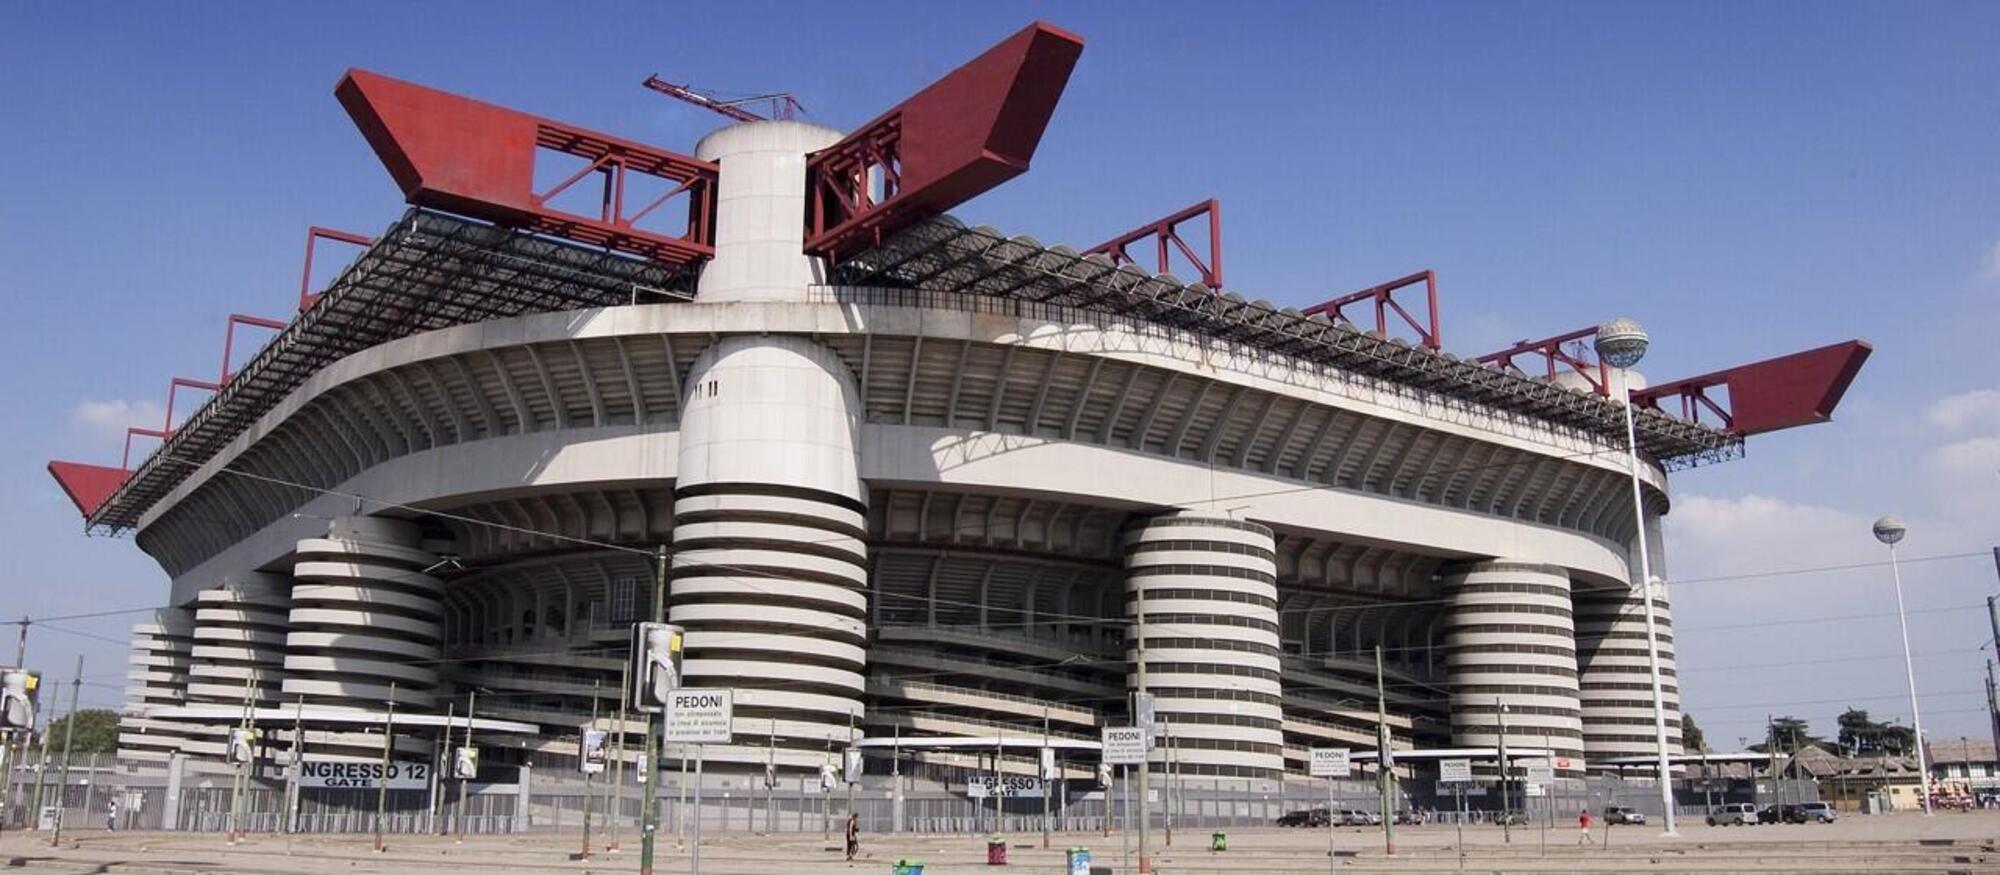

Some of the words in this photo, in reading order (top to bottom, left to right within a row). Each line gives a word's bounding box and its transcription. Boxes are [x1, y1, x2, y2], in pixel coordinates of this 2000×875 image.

[676, 695, 723, 708] PEDONI
[1109, 731, 1140, 741] PEDONI
[1315, 751, 1345, 759] PEDONI
[302, 761, 399, 779] NGRESSO
[405, 764, 426, 780] 12
[324, 778, 373, 788] GATE
